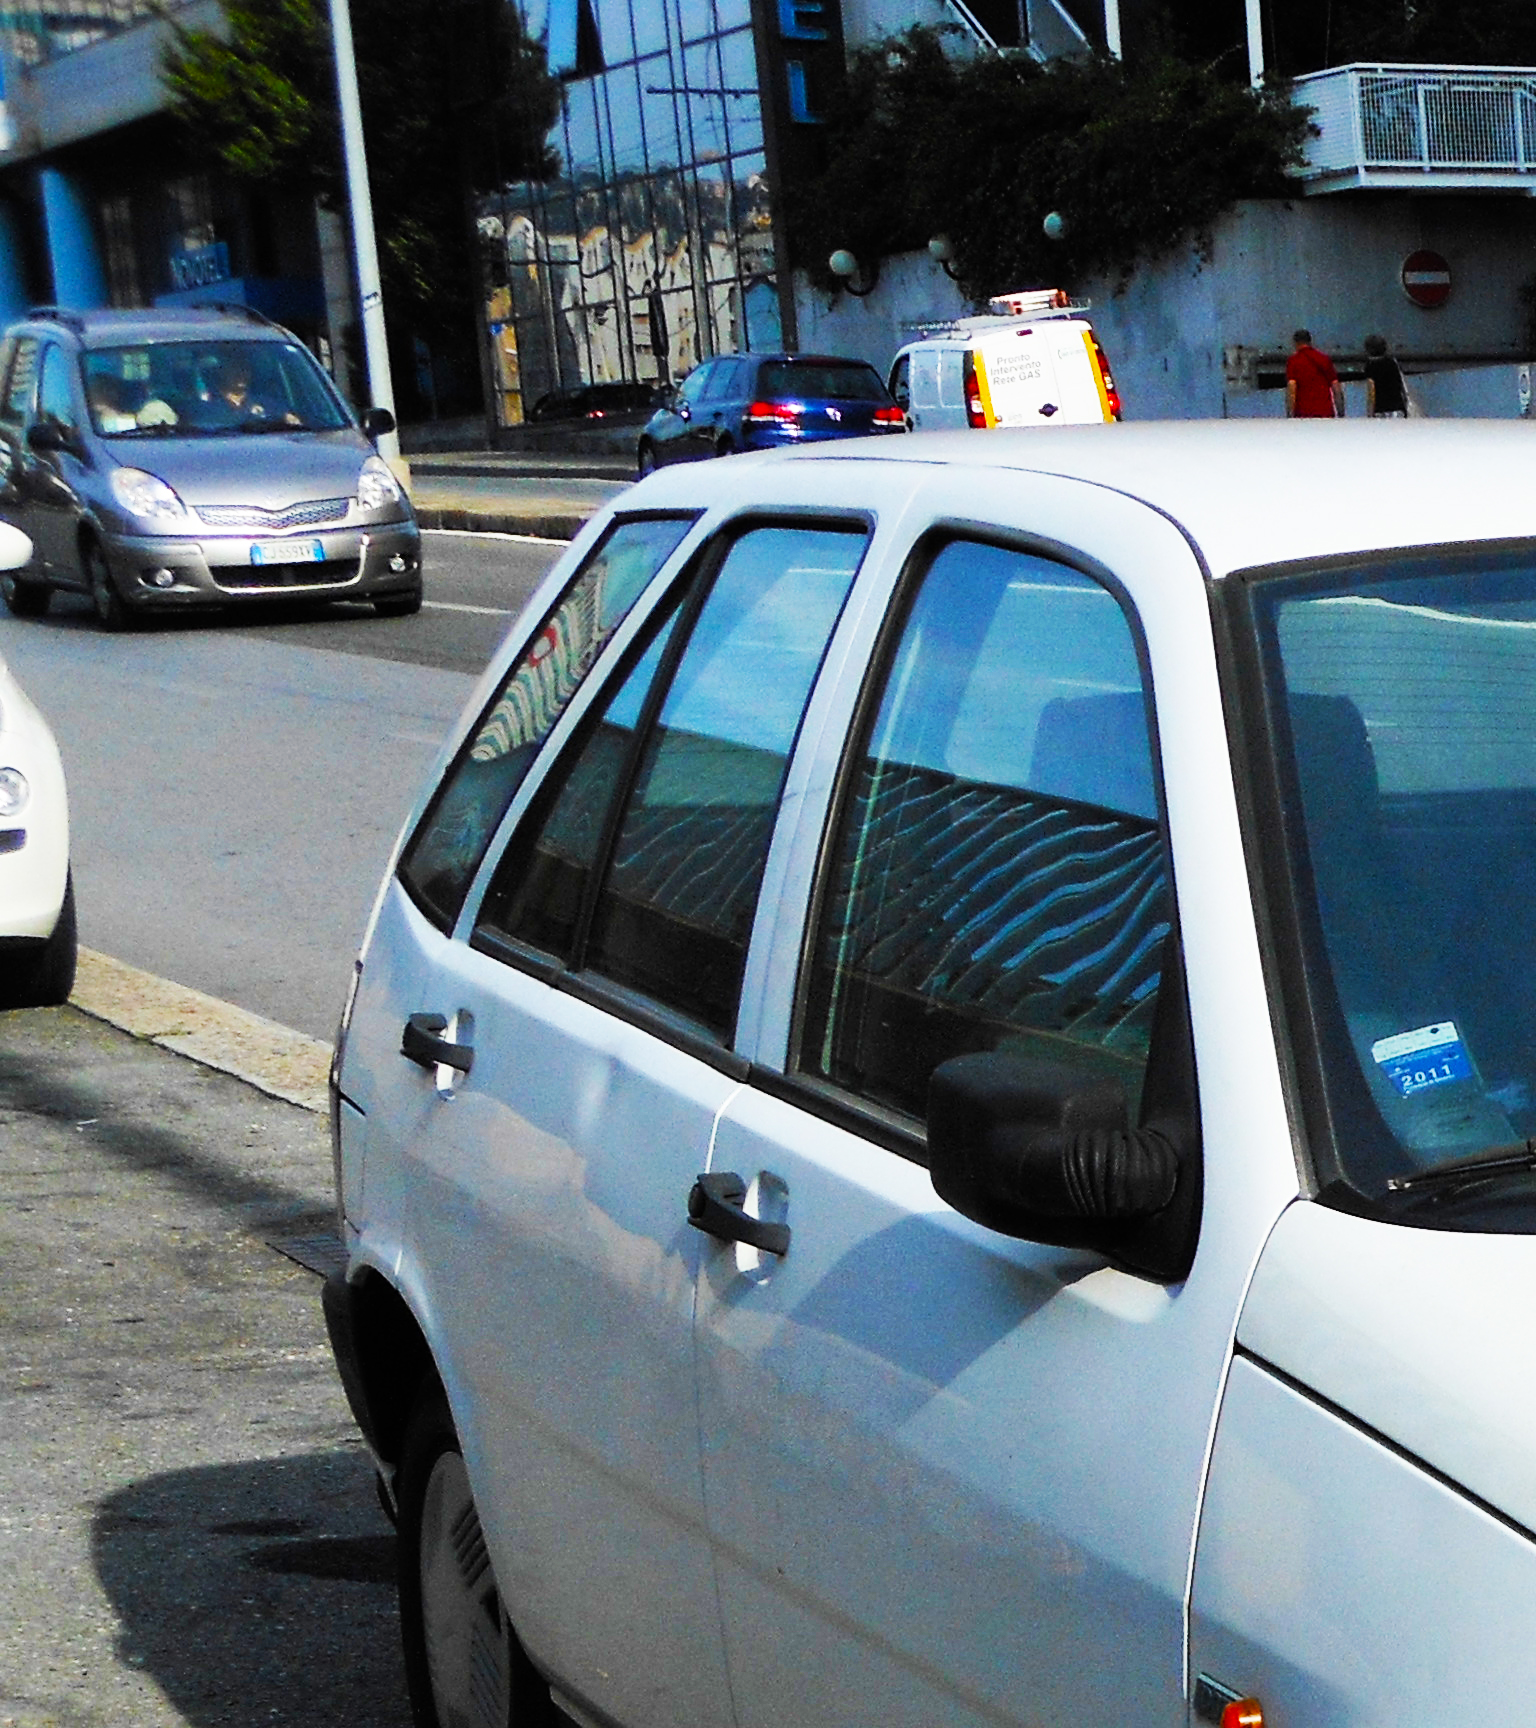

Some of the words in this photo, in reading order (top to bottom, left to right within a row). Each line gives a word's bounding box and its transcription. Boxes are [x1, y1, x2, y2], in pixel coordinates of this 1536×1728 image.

[996, 354, 1031, 366] Pronto
[990, 361, 1041, 376] Intervento
[993, 375, 1016, 385] Rete
[1019, 369, 1041, 381] GAS
[1401, 1064, 1451, 1086] 2011
